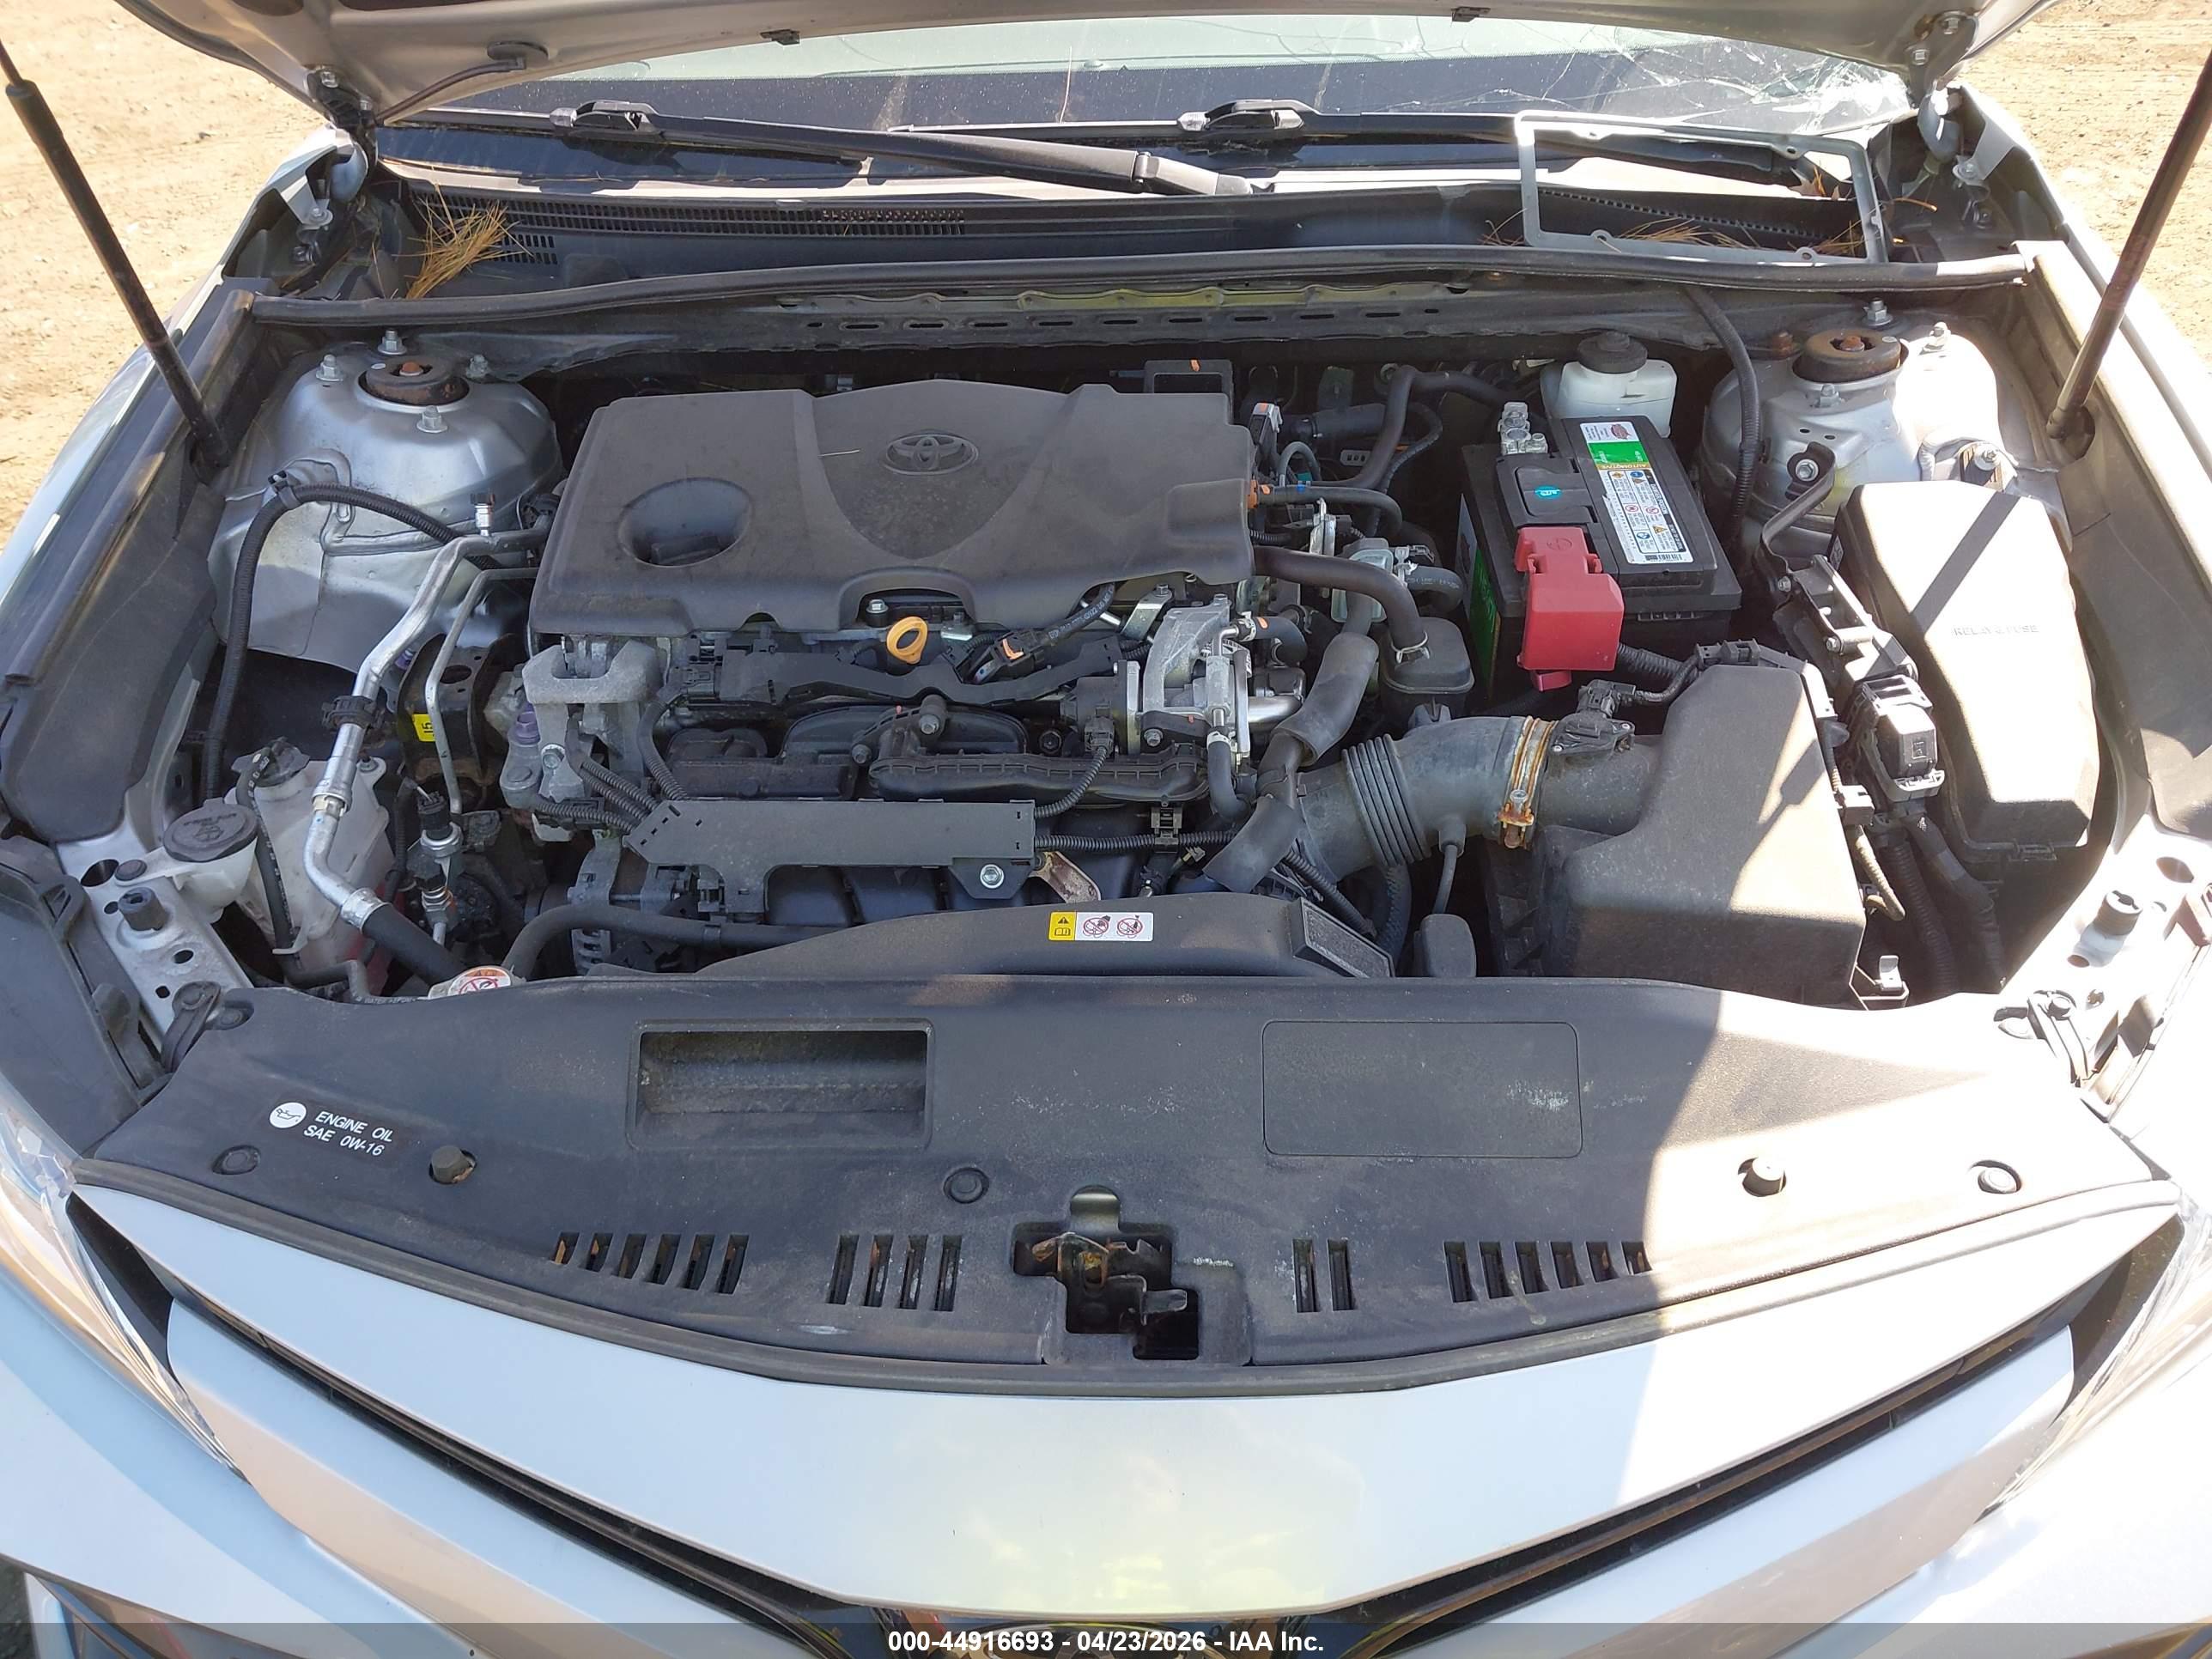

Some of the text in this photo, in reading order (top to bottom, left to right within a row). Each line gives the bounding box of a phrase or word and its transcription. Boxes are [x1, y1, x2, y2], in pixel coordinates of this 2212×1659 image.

[1953, 625, 1992, 636] RELAY
[303, 1125, 386, 1157] SAE 0W-16
[314, 1110, 393, 1143] ENGINE OIL
